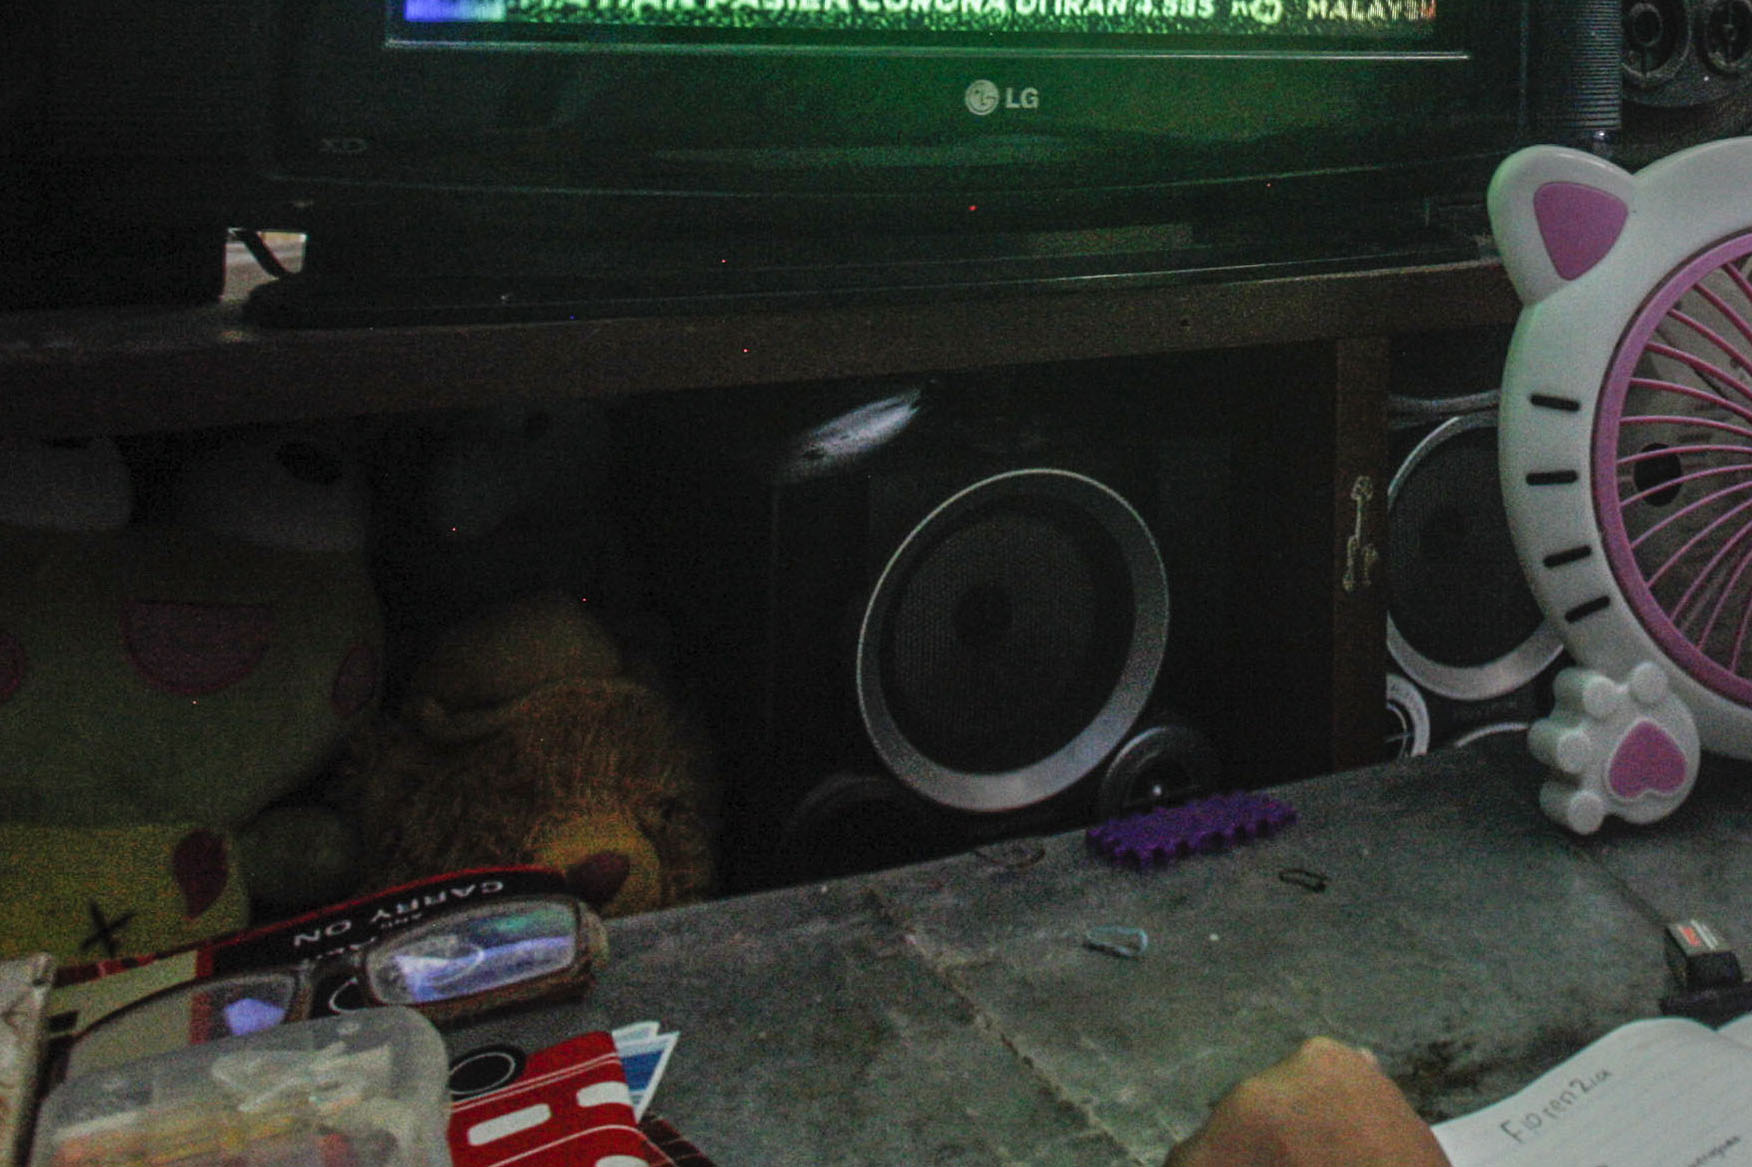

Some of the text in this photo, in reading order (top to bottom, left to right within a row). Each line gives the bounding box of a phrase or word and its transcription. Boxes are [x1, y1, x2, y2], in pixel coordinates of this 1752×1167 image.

[1005, 86, 1040, 109] LG
[369, 879, 504, 924] CARRY
[293, 919, 353, 947] ON
